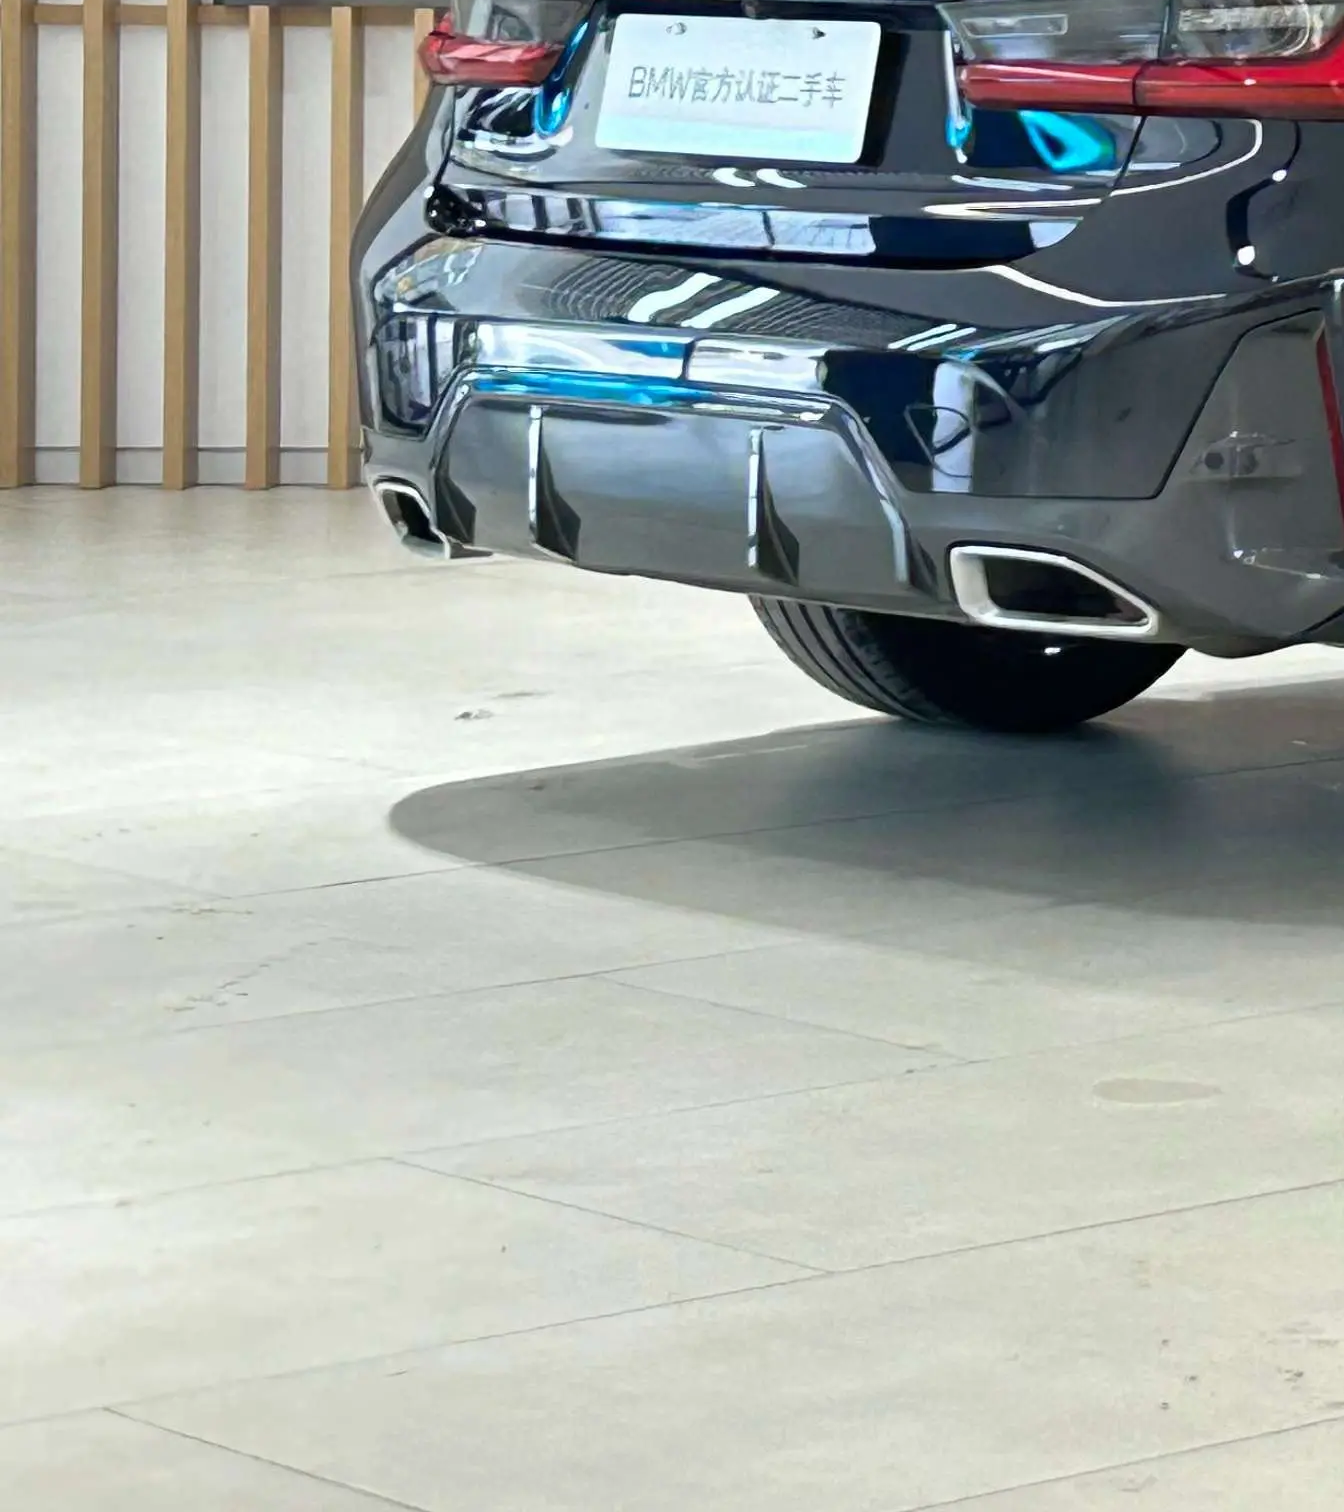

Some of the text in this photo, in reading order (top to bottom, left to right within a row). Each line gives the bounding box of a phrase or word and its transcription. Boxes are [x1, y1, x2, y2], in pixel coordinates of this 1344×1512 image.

[628, 65, 846, 109] BMW官方认证二手车
